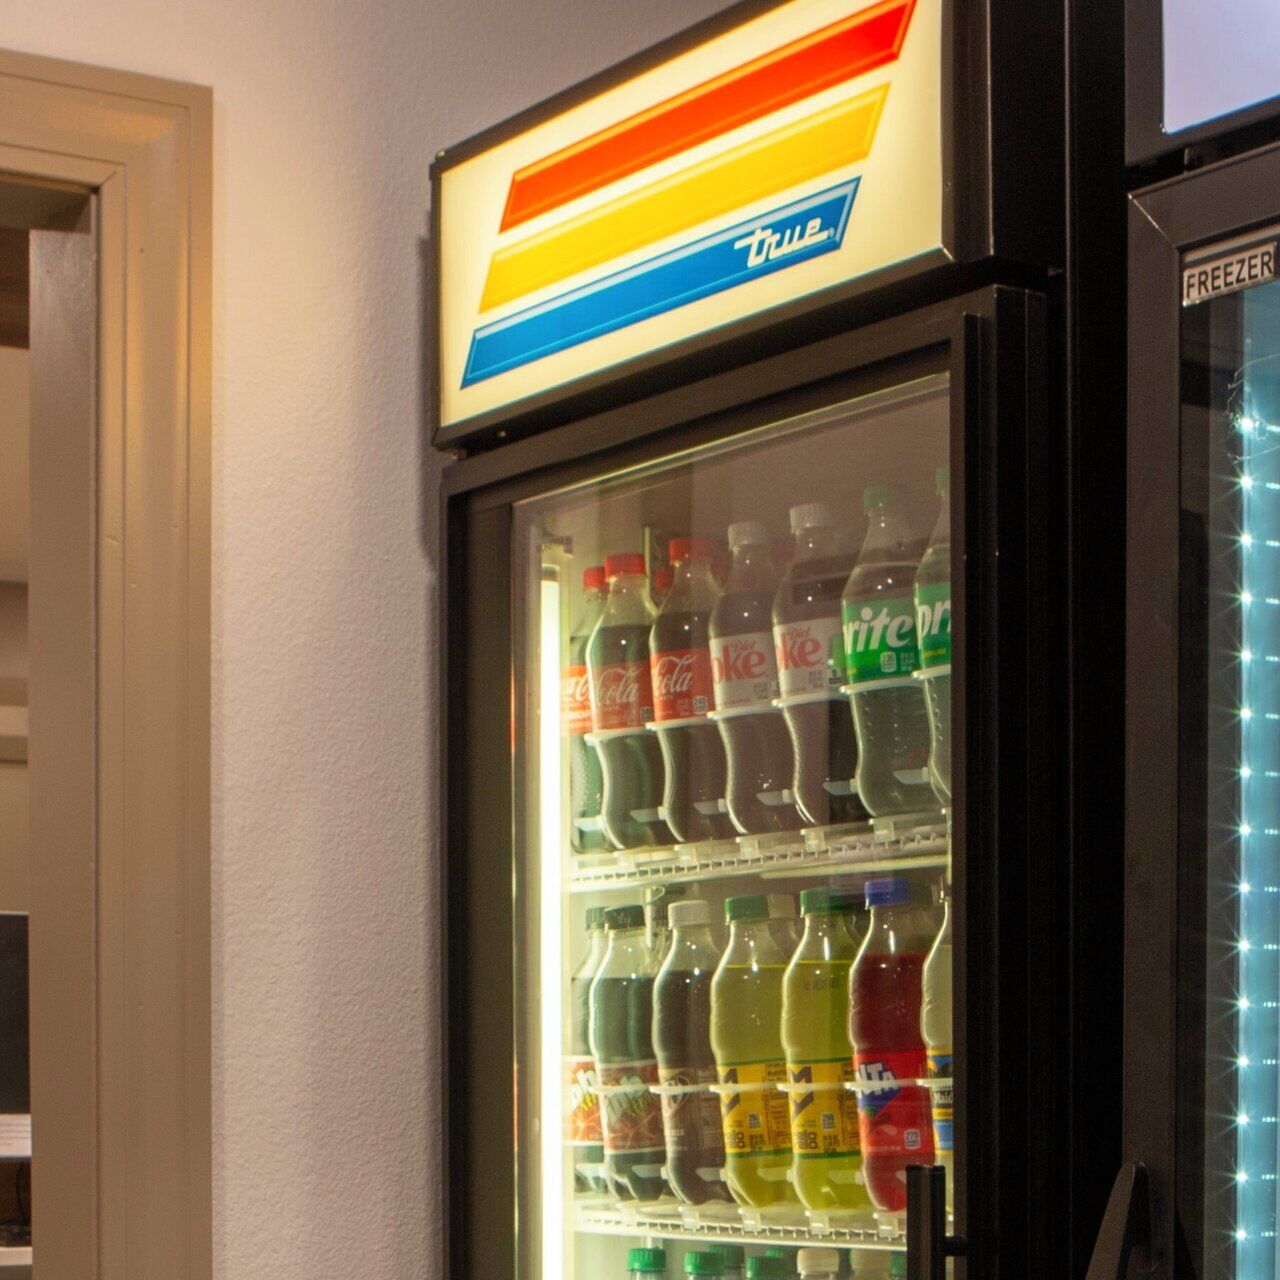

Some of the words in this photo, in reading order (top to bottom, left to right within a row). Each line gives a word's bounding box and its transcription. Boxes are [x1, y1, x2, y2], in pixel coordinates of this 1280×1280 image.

[1186, 249, 1274, 299] FREEZER
[842, 606, 914, 655] rite
[856, 1060, 897, 1097] NTA
